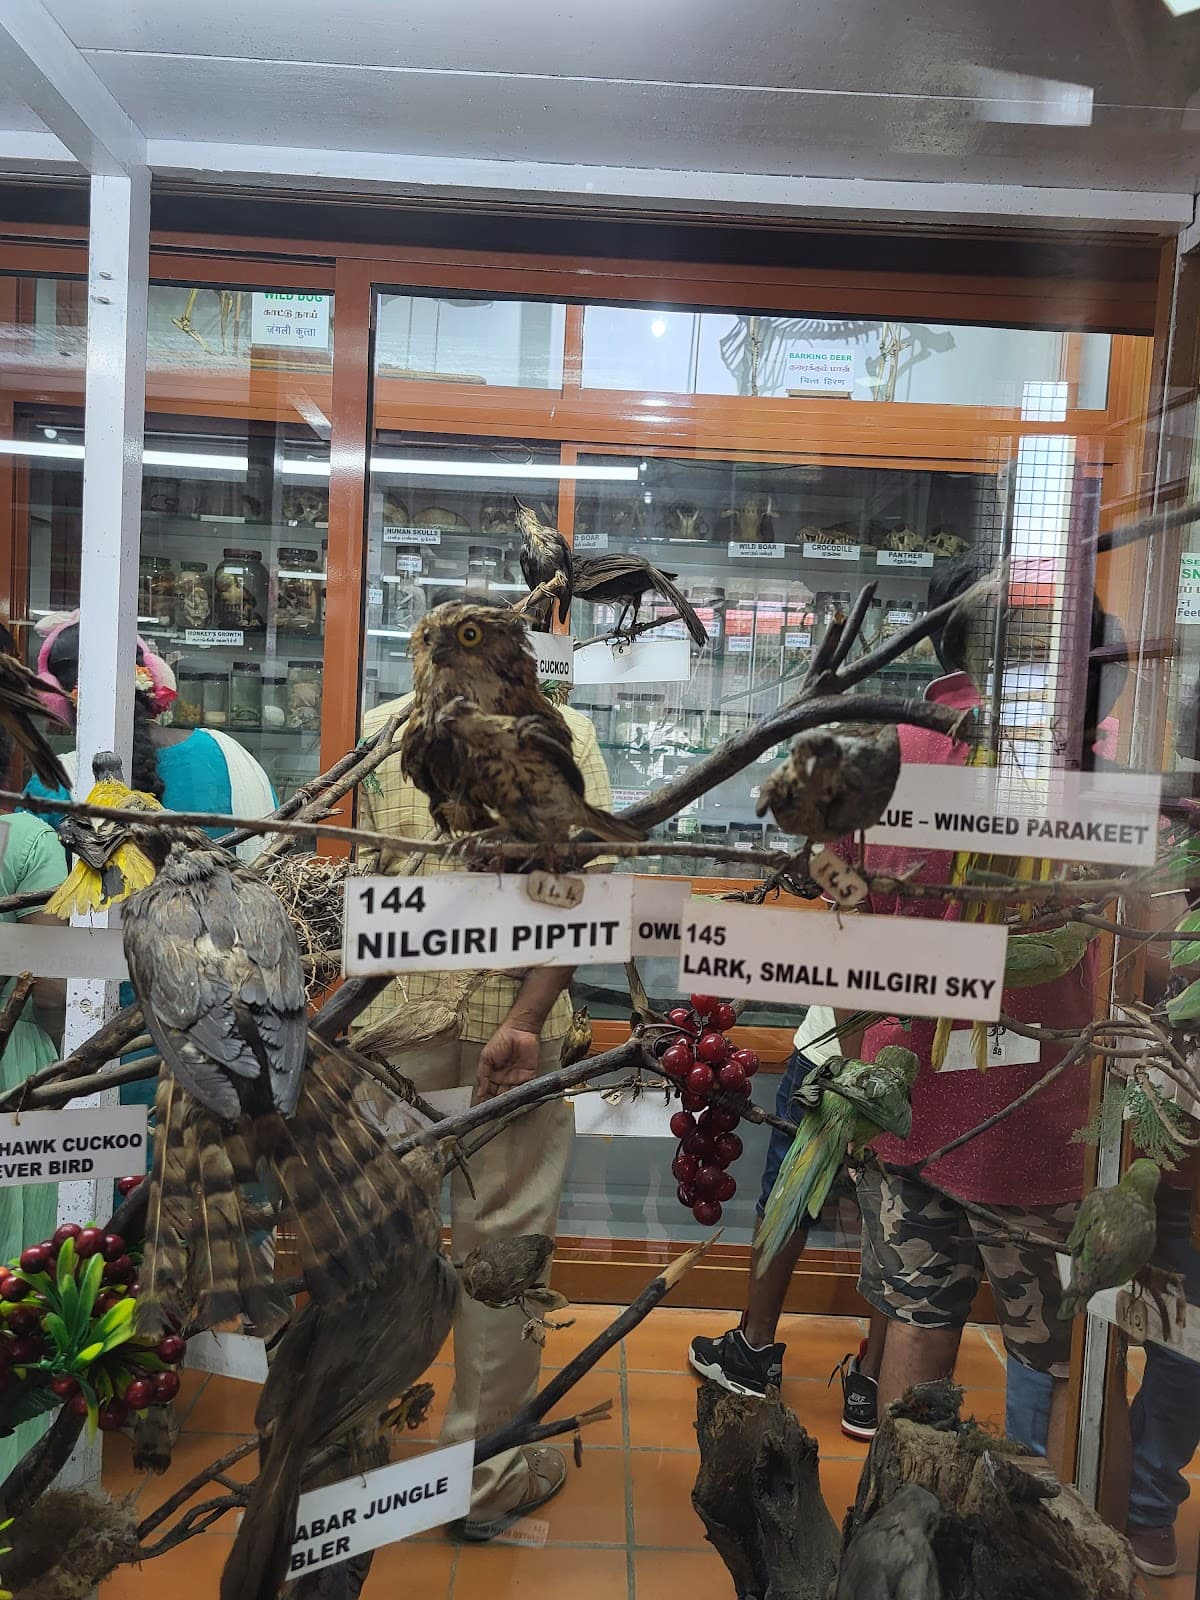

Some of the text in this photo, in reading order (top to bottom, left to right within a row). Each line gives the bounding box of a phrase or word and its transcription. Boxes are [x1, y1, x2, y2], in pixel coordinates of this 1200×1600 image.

[811, 544, 853, 553] CROCODILE
[888, 551, 923, 559] PANTHER
[540, 659, 569, 675] CUCKOO
[934, 812, 1019, 837] WINGED
[1026, 818, 1149, 845] PARAKEET
[358, 886, 426, 914] 144
[357, 921, 620, 960] NILGIRI PIPTIT
[639, 922, 682, 940] OWL
[686, 925, 726, 946] 145
[683, 954, 997, 1000] LARK, SMALL NILGIRI SKY
[0, 1133, 143, 1157] HAWK CUCKOO
[48, 1158, 94, 1175] BIRD
[292, 1476, 449, 1545] ABAR JUNGLE
[290, 1536, 351, 1572] BLER
